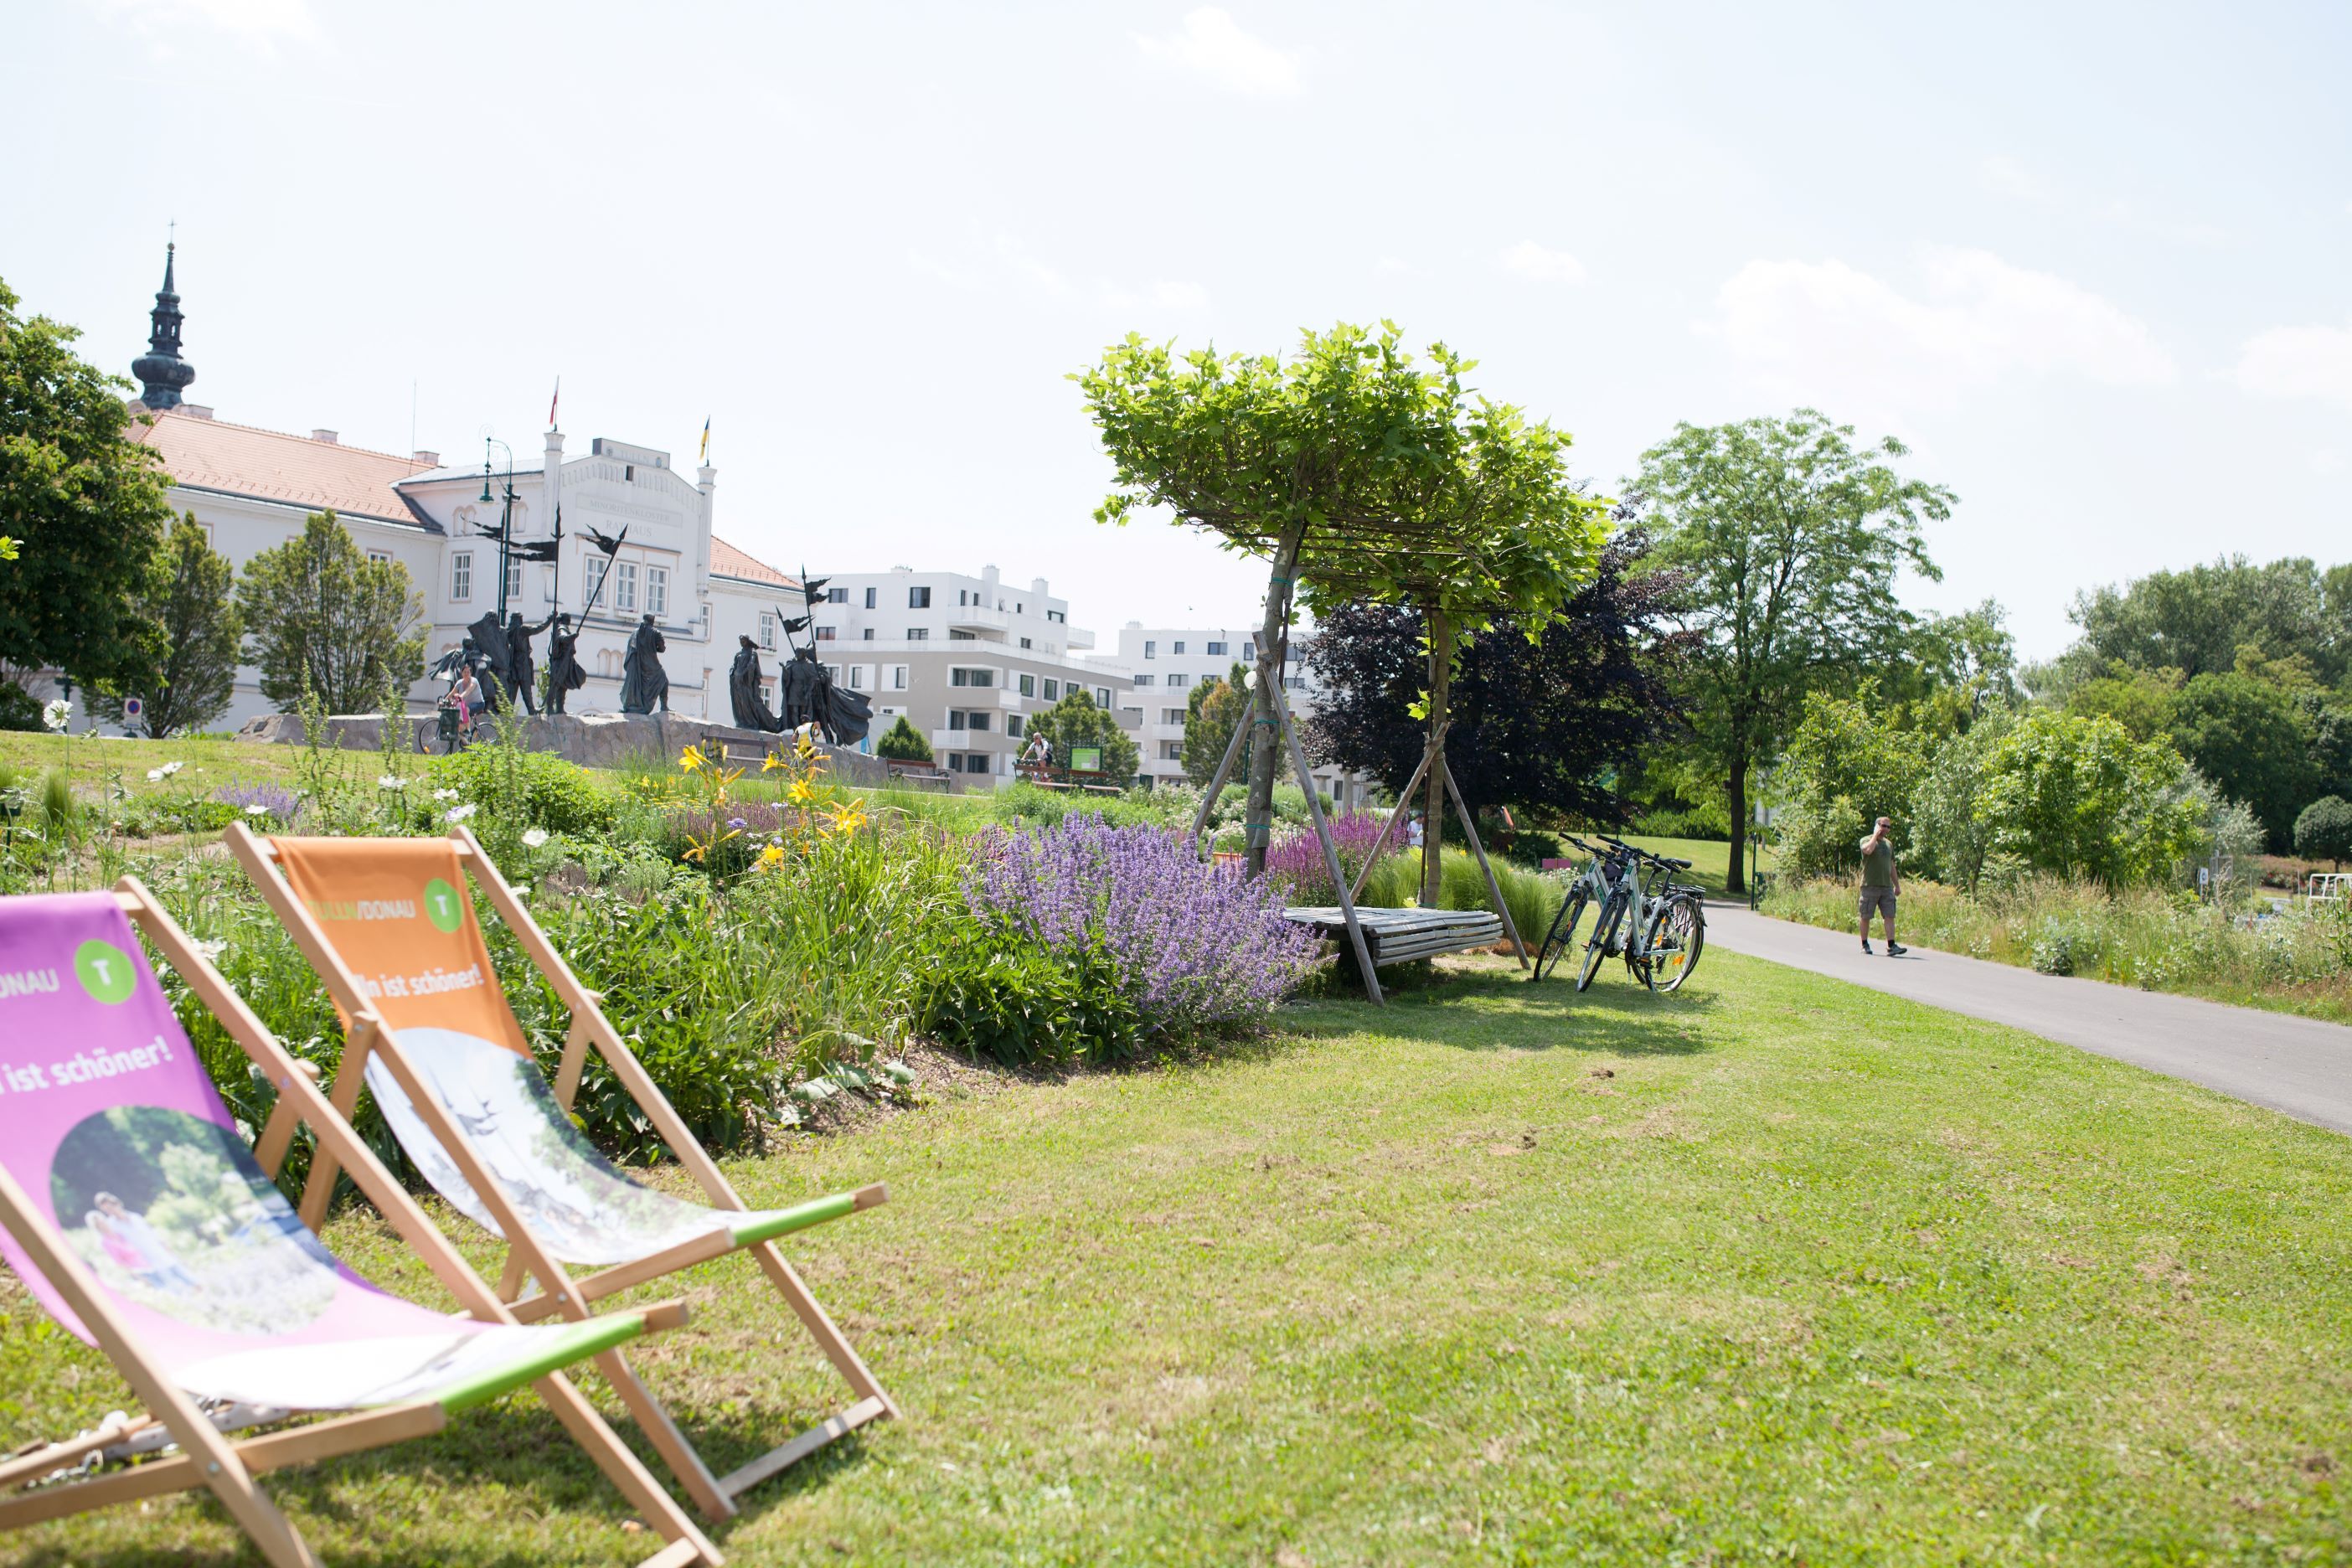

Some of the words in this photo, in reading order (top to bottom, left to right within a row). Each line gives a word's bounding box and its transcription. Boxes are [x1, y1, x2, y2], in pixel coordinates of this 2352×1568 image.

[590, 500, 670, 522] MINORITENKLOSTER
[435, 895, 447, 916] T
[91, 957, 112, 987] T
[379, 973, 410, 998] ist
[409, 962, 485, 996] schöner!
[2, 1062, 50, 1092] ist
[49, 1034, 174, 1086] schöner!
